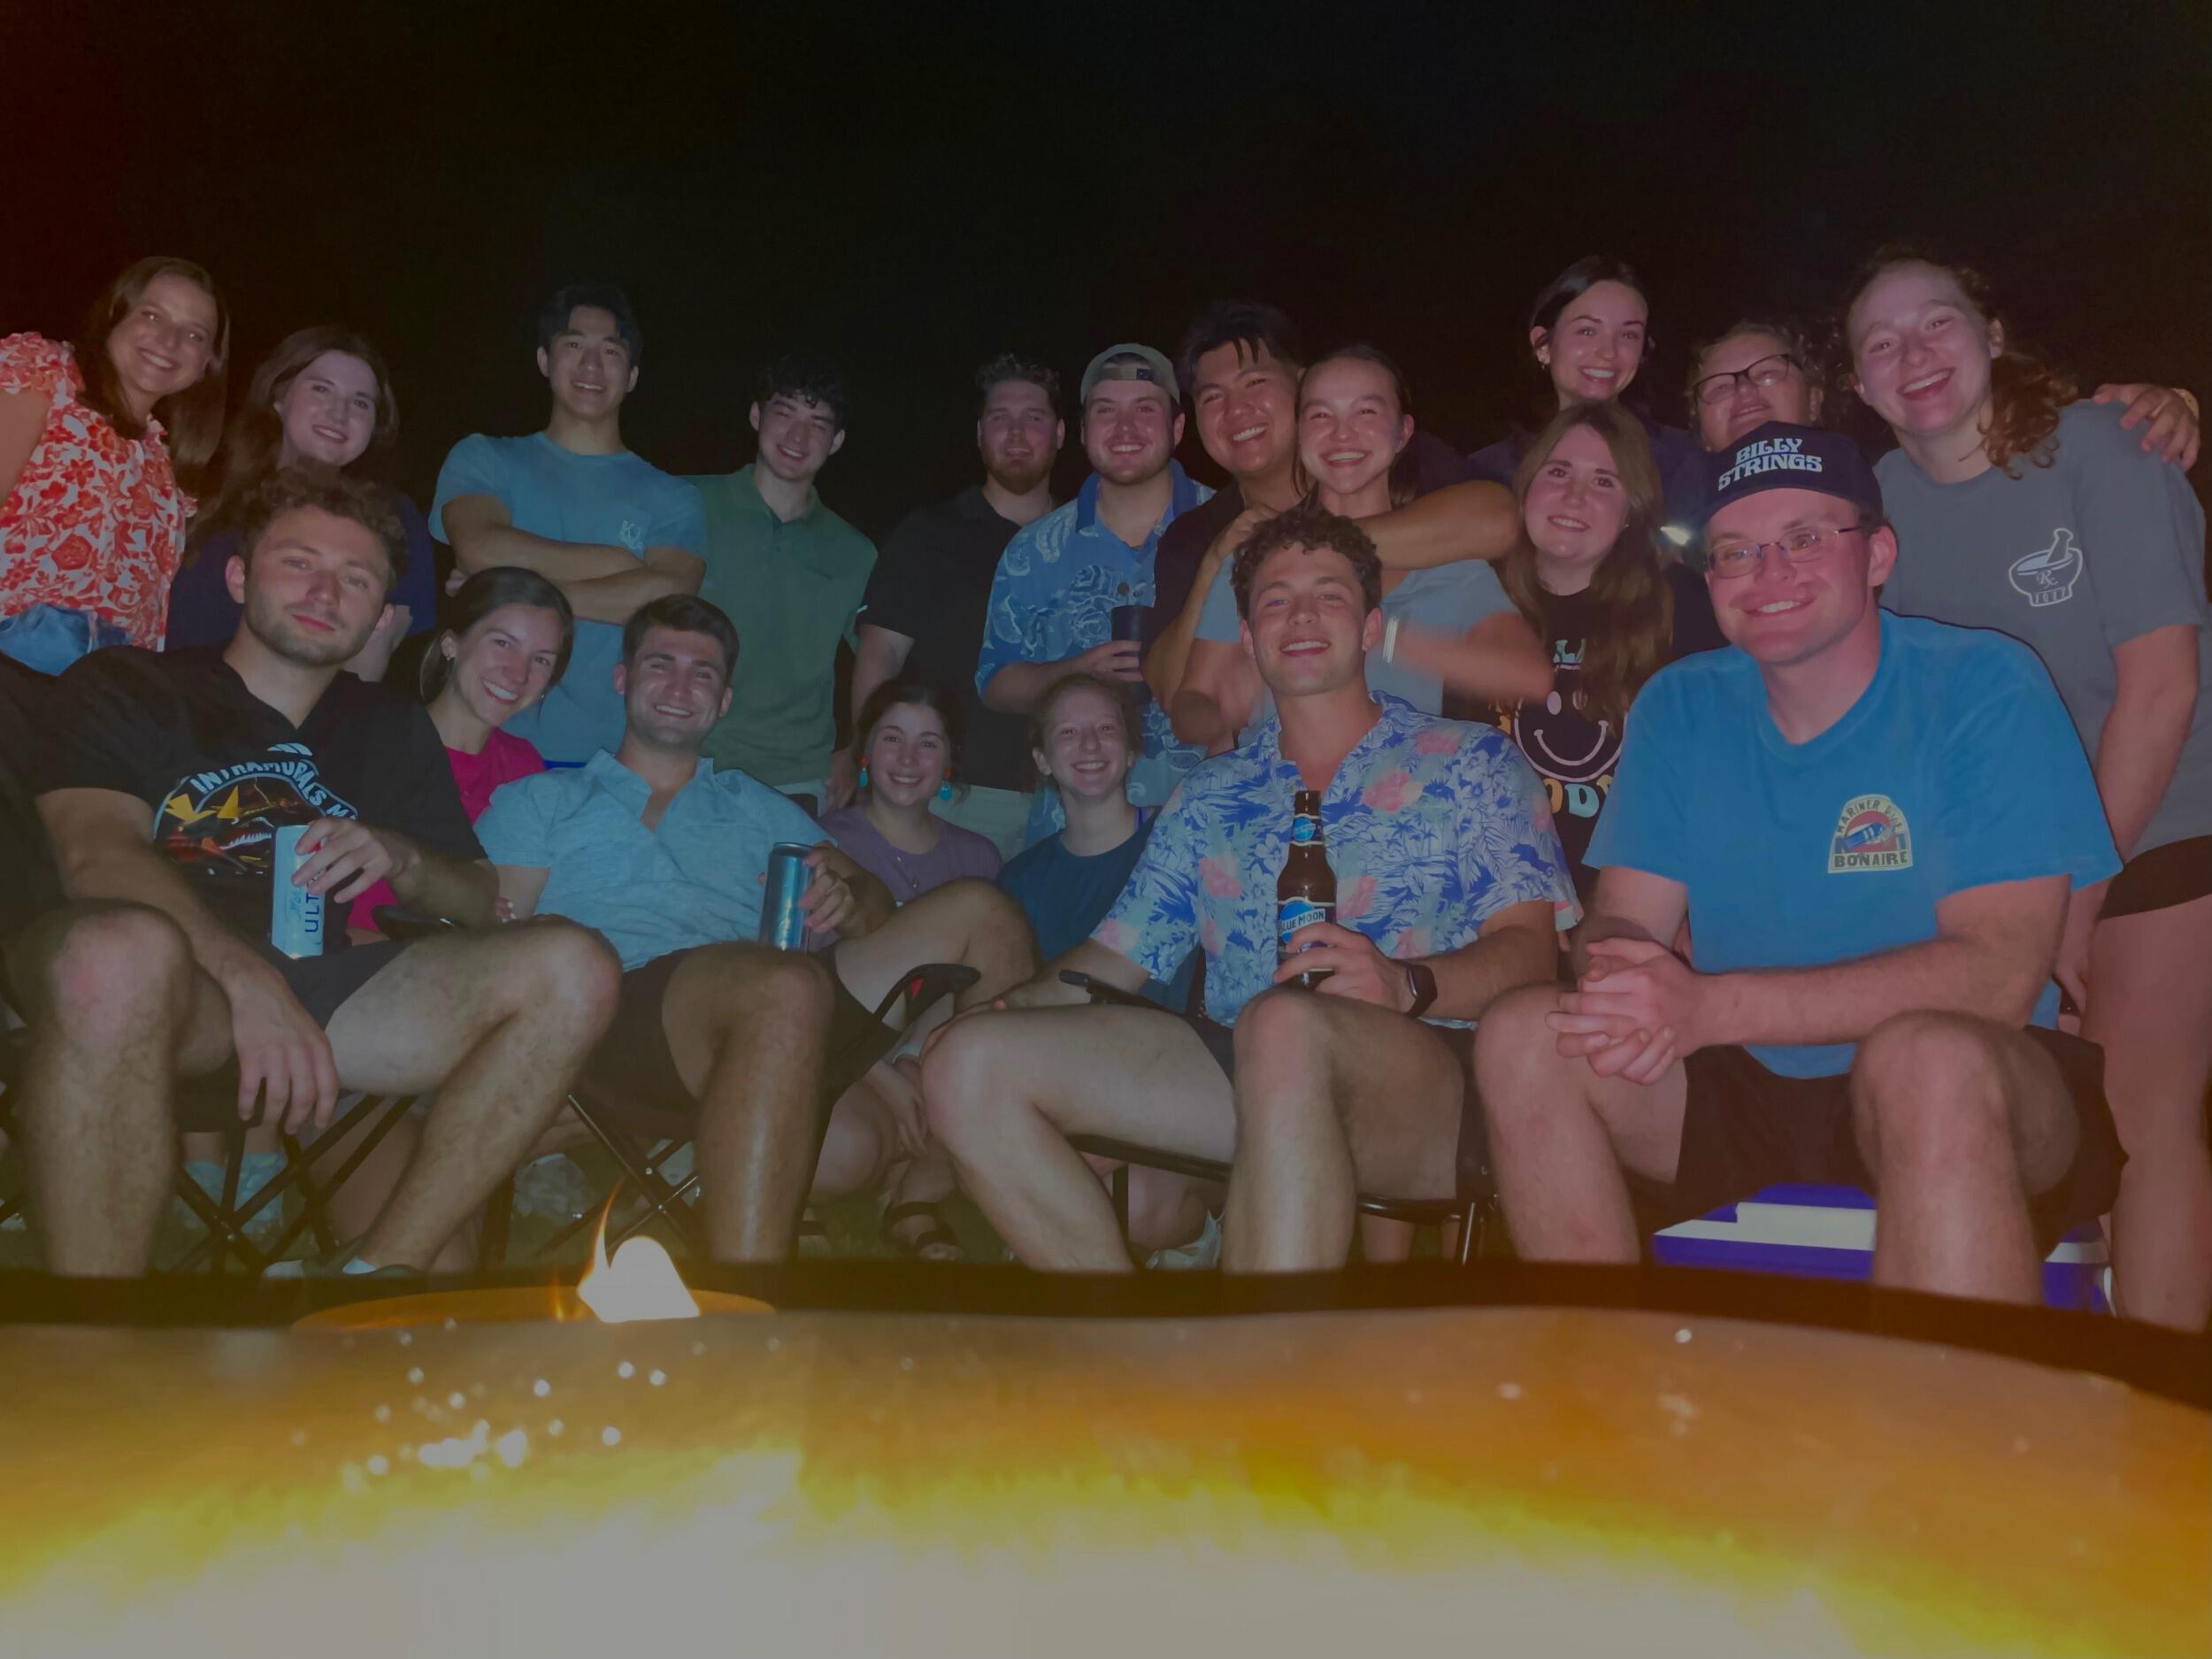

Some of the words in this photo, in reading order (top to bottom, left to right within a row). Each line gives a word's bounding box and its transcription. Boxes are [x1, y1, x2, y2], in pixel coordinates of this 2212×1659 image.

[1735, 437, 1803, 465] BILLY
[1718, 454, 1823, 492] STRINGS
[1834, 850, 1909, 868] BONAIRE
[1298, 910, 1325, 926] MOON
